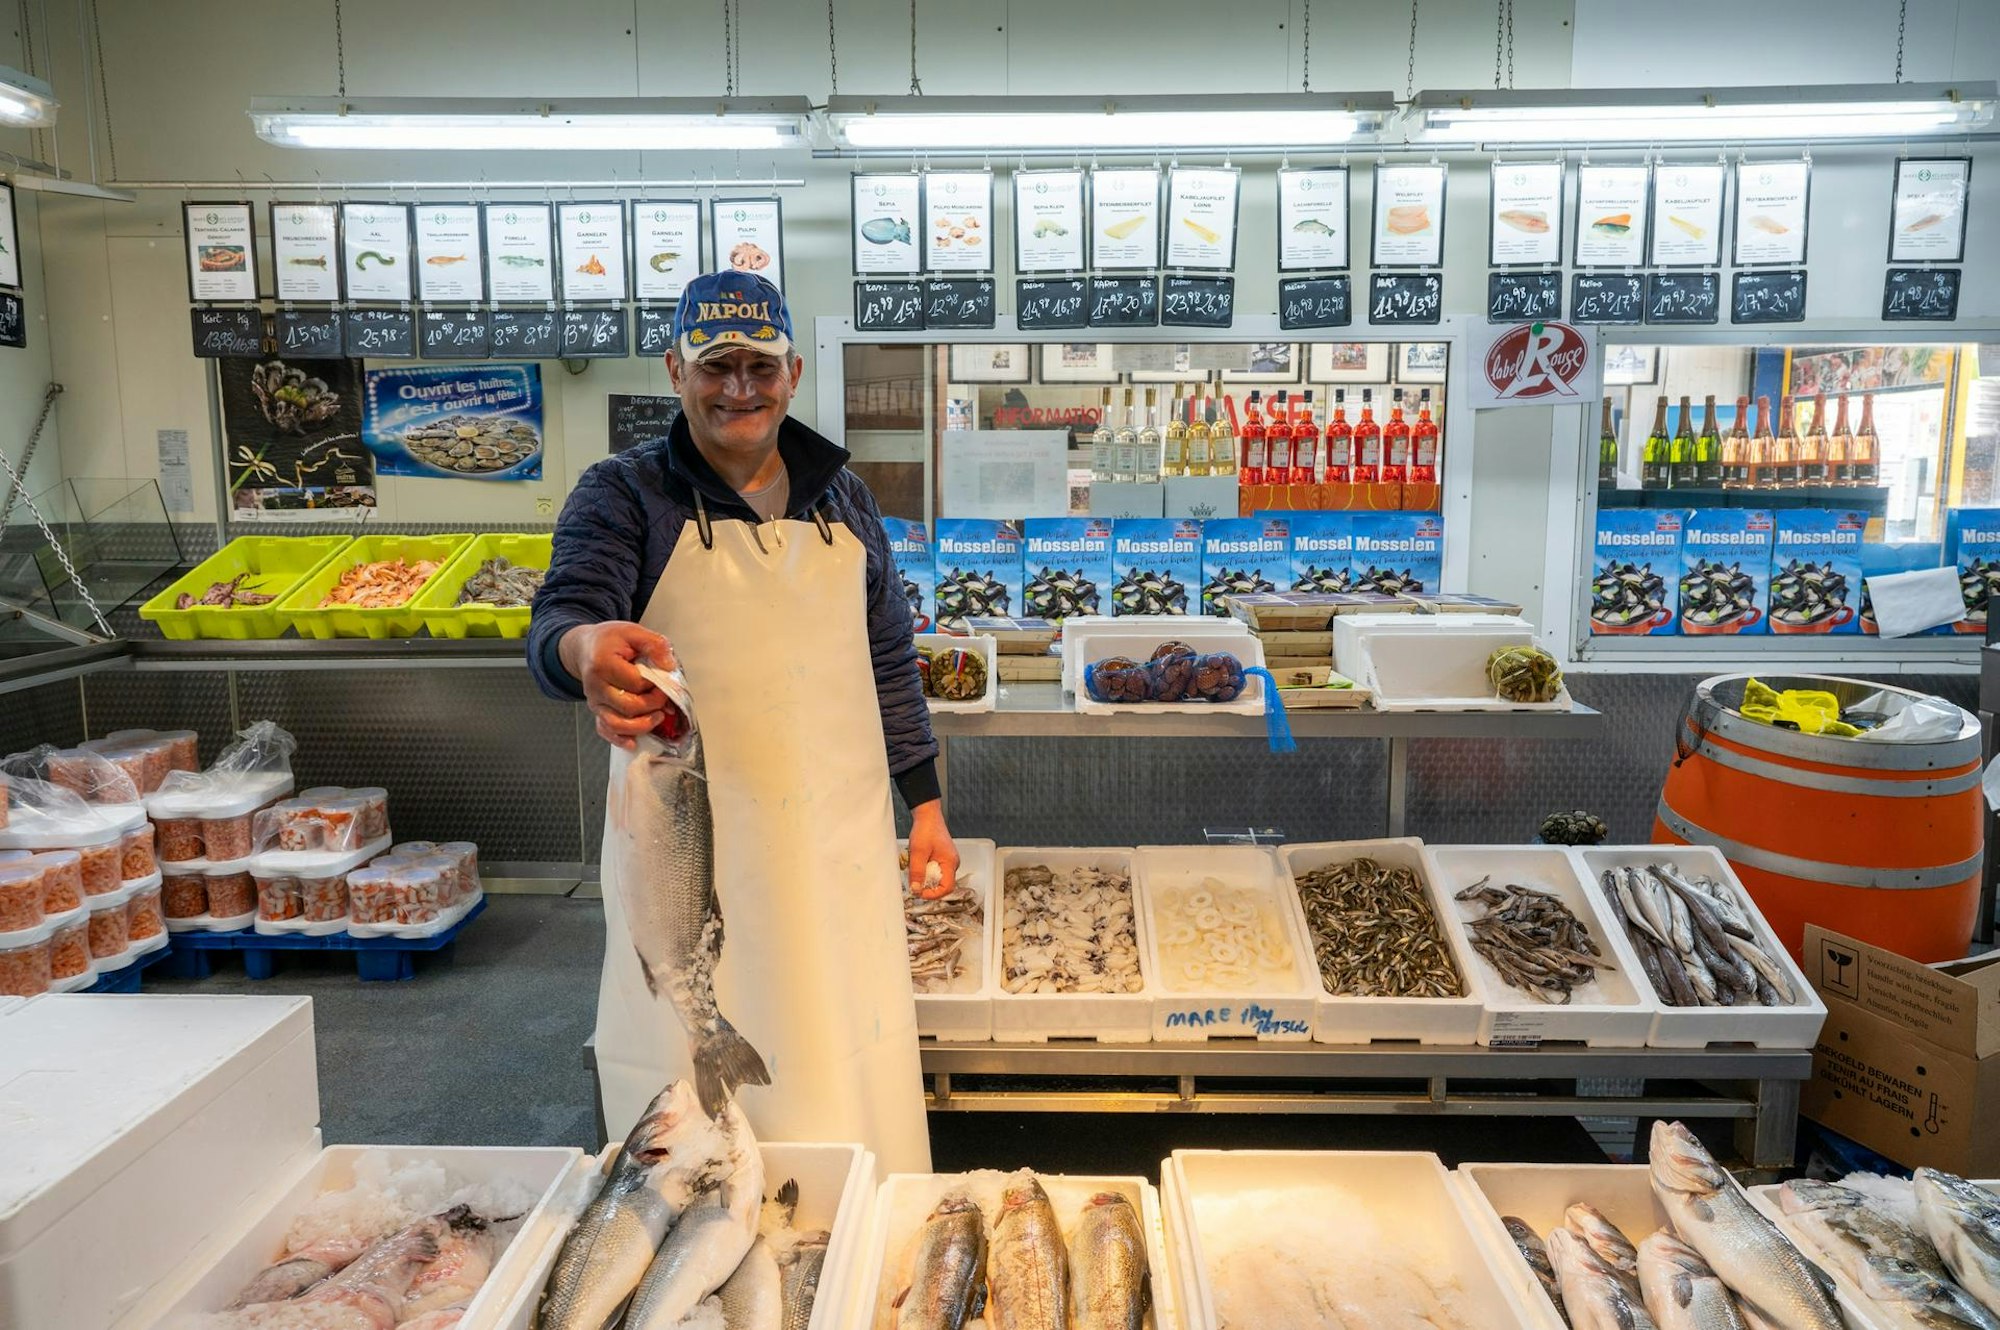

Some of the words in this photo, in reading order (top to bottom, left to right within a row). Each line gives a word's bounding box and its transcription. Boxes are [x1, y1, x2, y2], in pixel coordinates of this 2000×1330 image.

[1180, 193, 1226, 202] KABELJAUFILET
[696, 301, 772, 323] NAPOLI
[1491, 349, 1524, 382] label
[400, 383, 452, 400] Ouvrir
[456, 381, 477, 394] les
[479, 378, 517, 391] huîtres,
[394, 402, 440, 419] c'est
[443, 396, 483, 411] ouvrir
[485, 394, 495, 404] la
[496, 390, 516, 402] fête
[1295, 536, 1352, 552] Mossel
[1355, 536, 1435, 552] Mosselen
[1597, 530, 1675, 546] Mosselen
[1686, 529, 1765, 545] Mosselen
[1778, 529, 1857, 545] Mosselen
[1962, 528, 2000, 544] Moss
[889, 538, 926, 553] selen
[939, 537, 1016, 554] Mosselen
[1028, 537, 1105, 553] Mosselen
[1116, 537, 1194, 554] Mosselen
[1206, 537, 1284, 554] Mosselen
[1867, 968, 1894, 986] Handle
[1895, 983, 1913, 993] with
[1913, 990, 1933, 1002] care,
[1933, 996, 1960, 1014] fragile
[1166, 1007, 1231, 1028] MARE
[1904, 1013, 1930, 1030] fragile
[1817, 1043, 1866, 1072] GEKOELD
[1867, 1066, 1923, 1098] BEWAREN
[1828, 1060, 1857, 1080] TENIR
[1859, 1076, 1875, 1088] AU
[1876, 1083, 1910, 1105] FRAIS
[1820, 1069, 1867, 1098] GEKÜHLT
[1869, 1092, 1914, 1120] LAGERN
